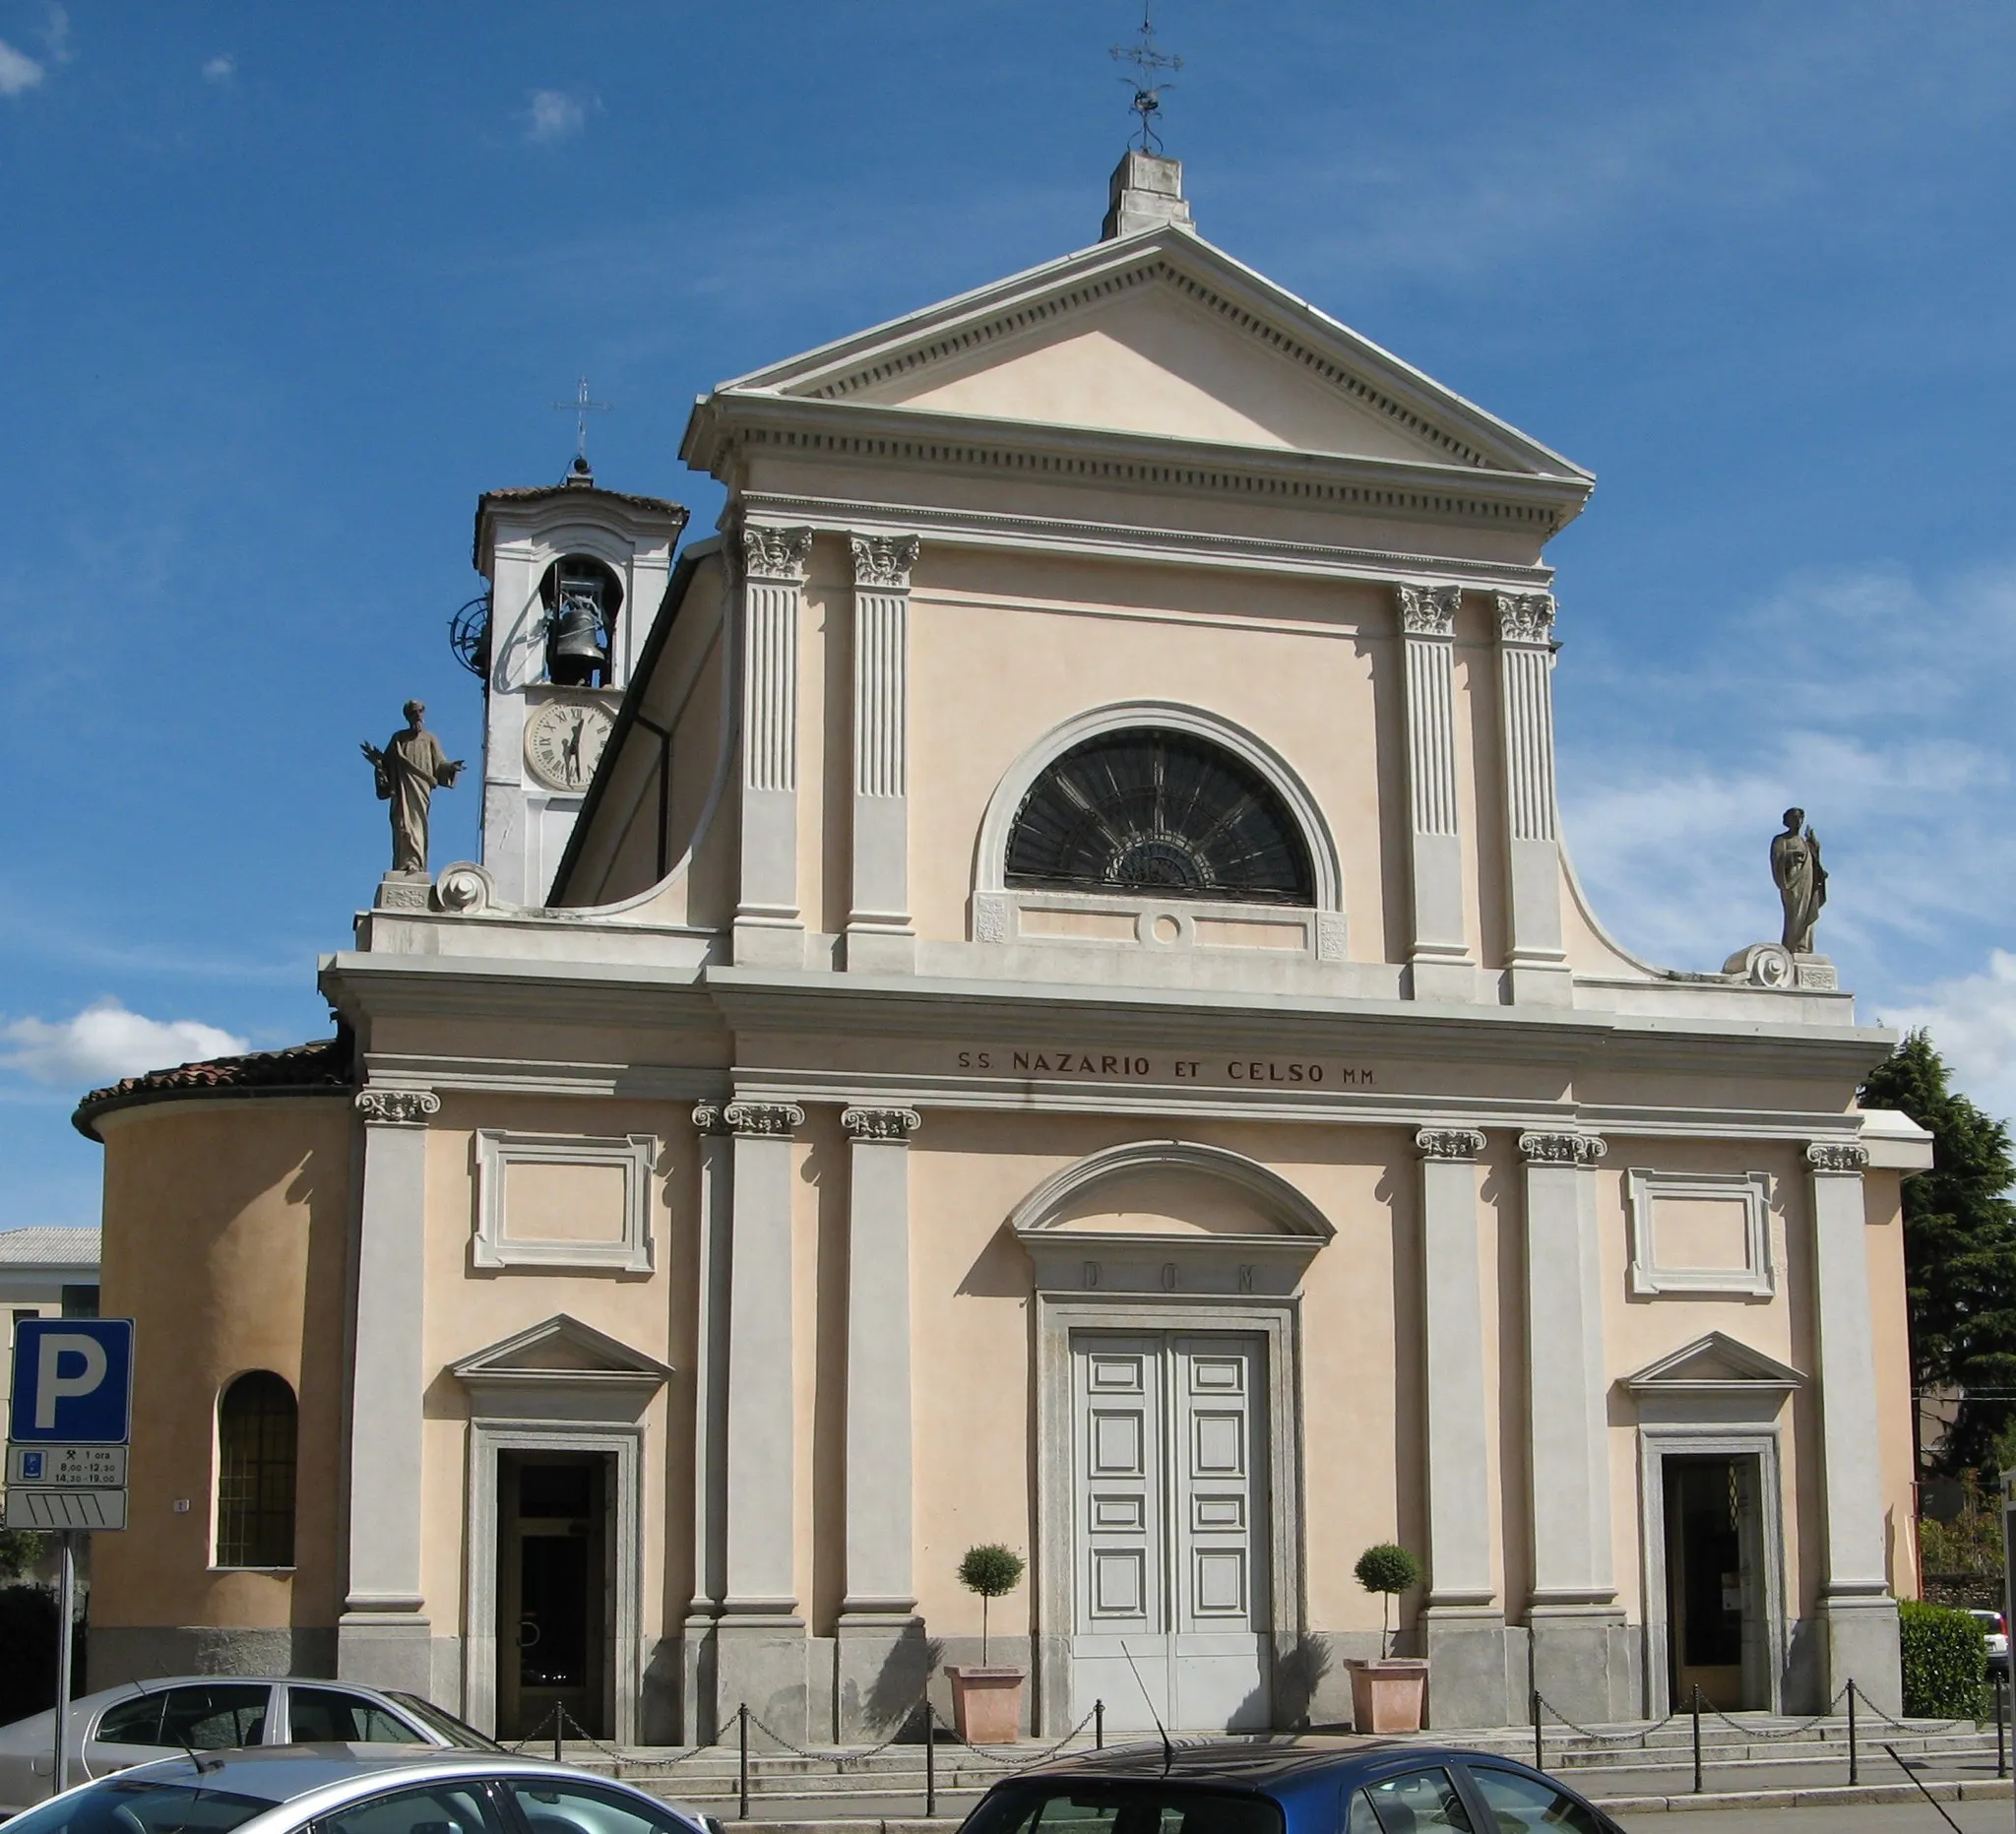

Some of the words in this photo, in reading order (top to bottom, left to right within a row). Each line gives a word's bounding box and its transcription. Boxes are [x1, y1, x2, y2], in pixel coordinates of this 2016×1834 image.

[1013, 1051, 1151, 1076] NAZARIO
[1174, 1061, 1201, 1078] ET
[1227, 1061, 1324, 1083] CELSO
[34, 1333, 107, 1428] P
